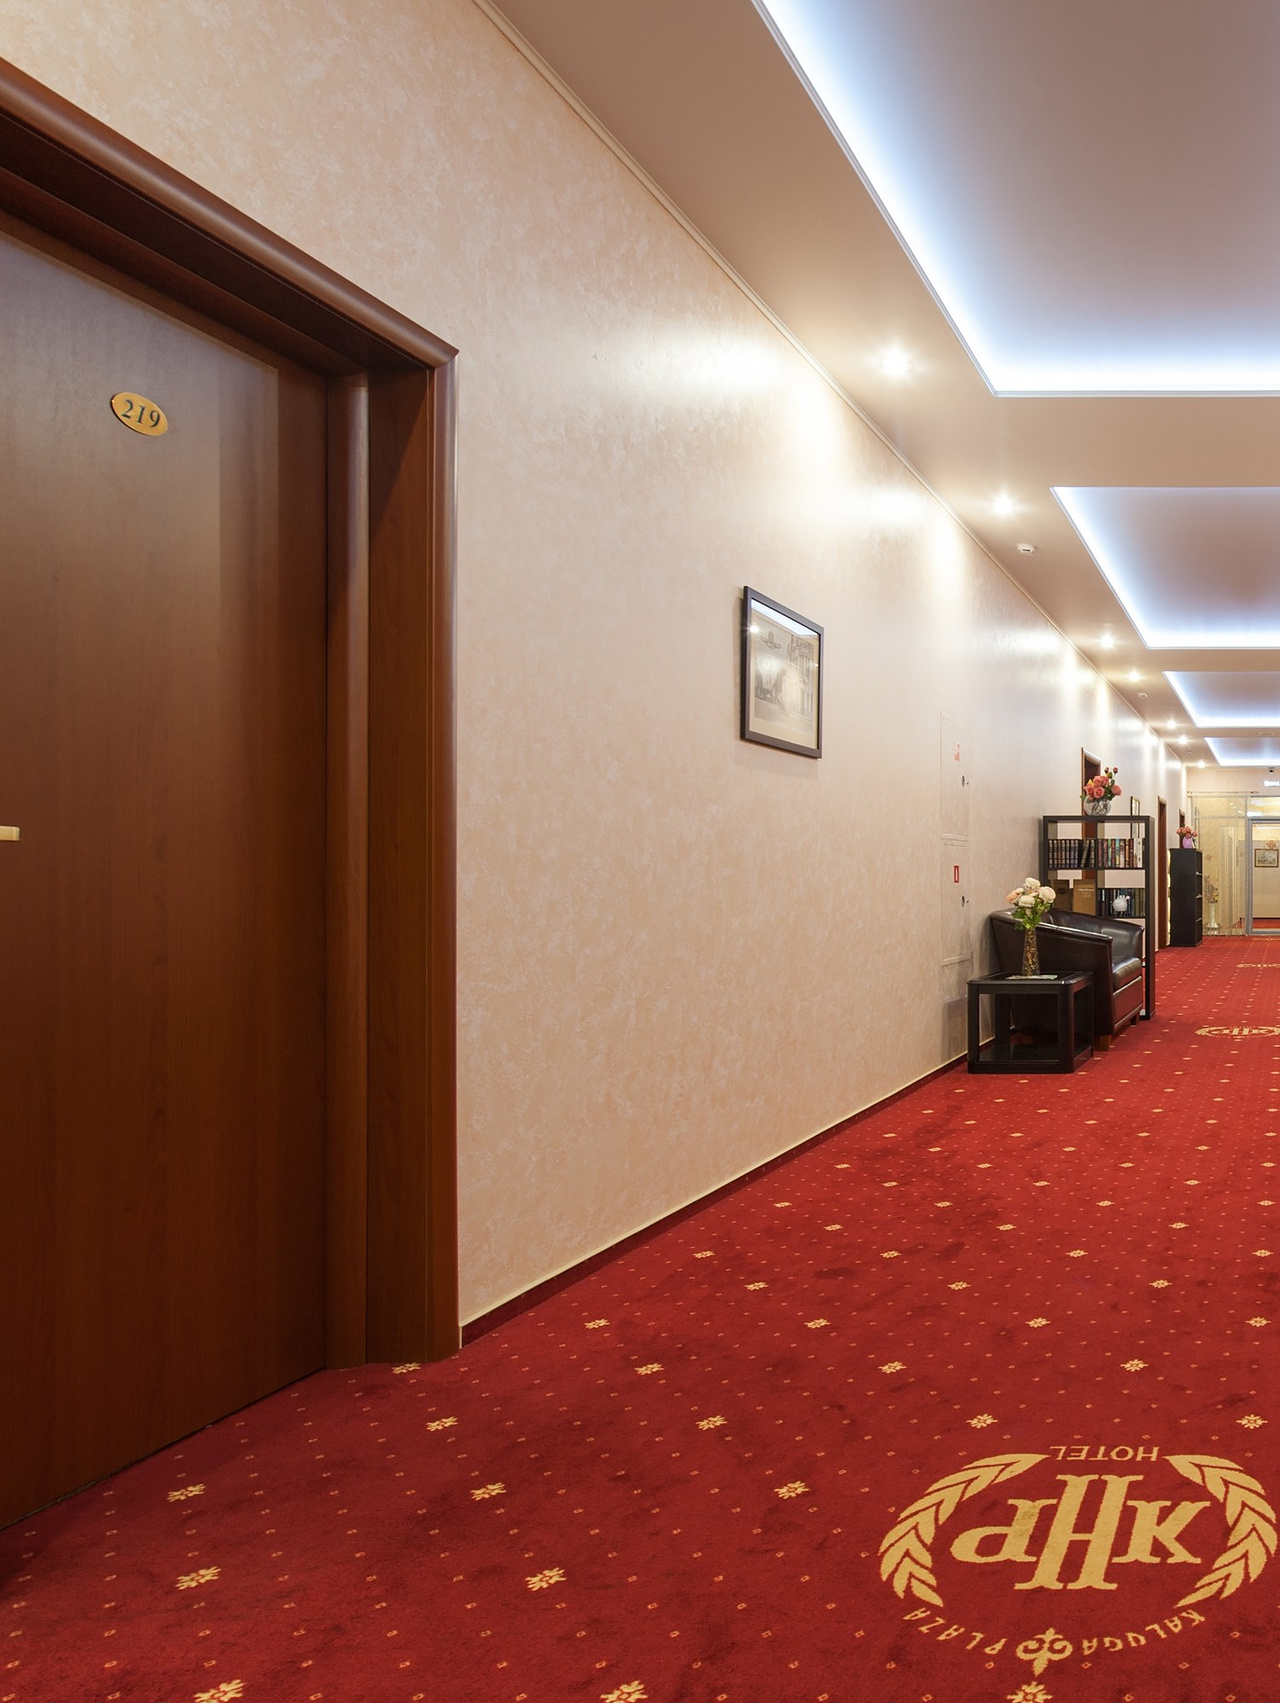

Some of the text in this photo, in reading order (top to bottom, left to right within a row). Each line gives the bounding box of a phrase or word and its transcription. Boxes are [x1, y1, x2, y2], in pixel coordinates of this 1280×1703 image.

[121, 399, 160, 428] 219
[1049, 1445, 1161, 1462] HOTEL
[902, 1606, 1206, 1656] KALUGA PLAZA
